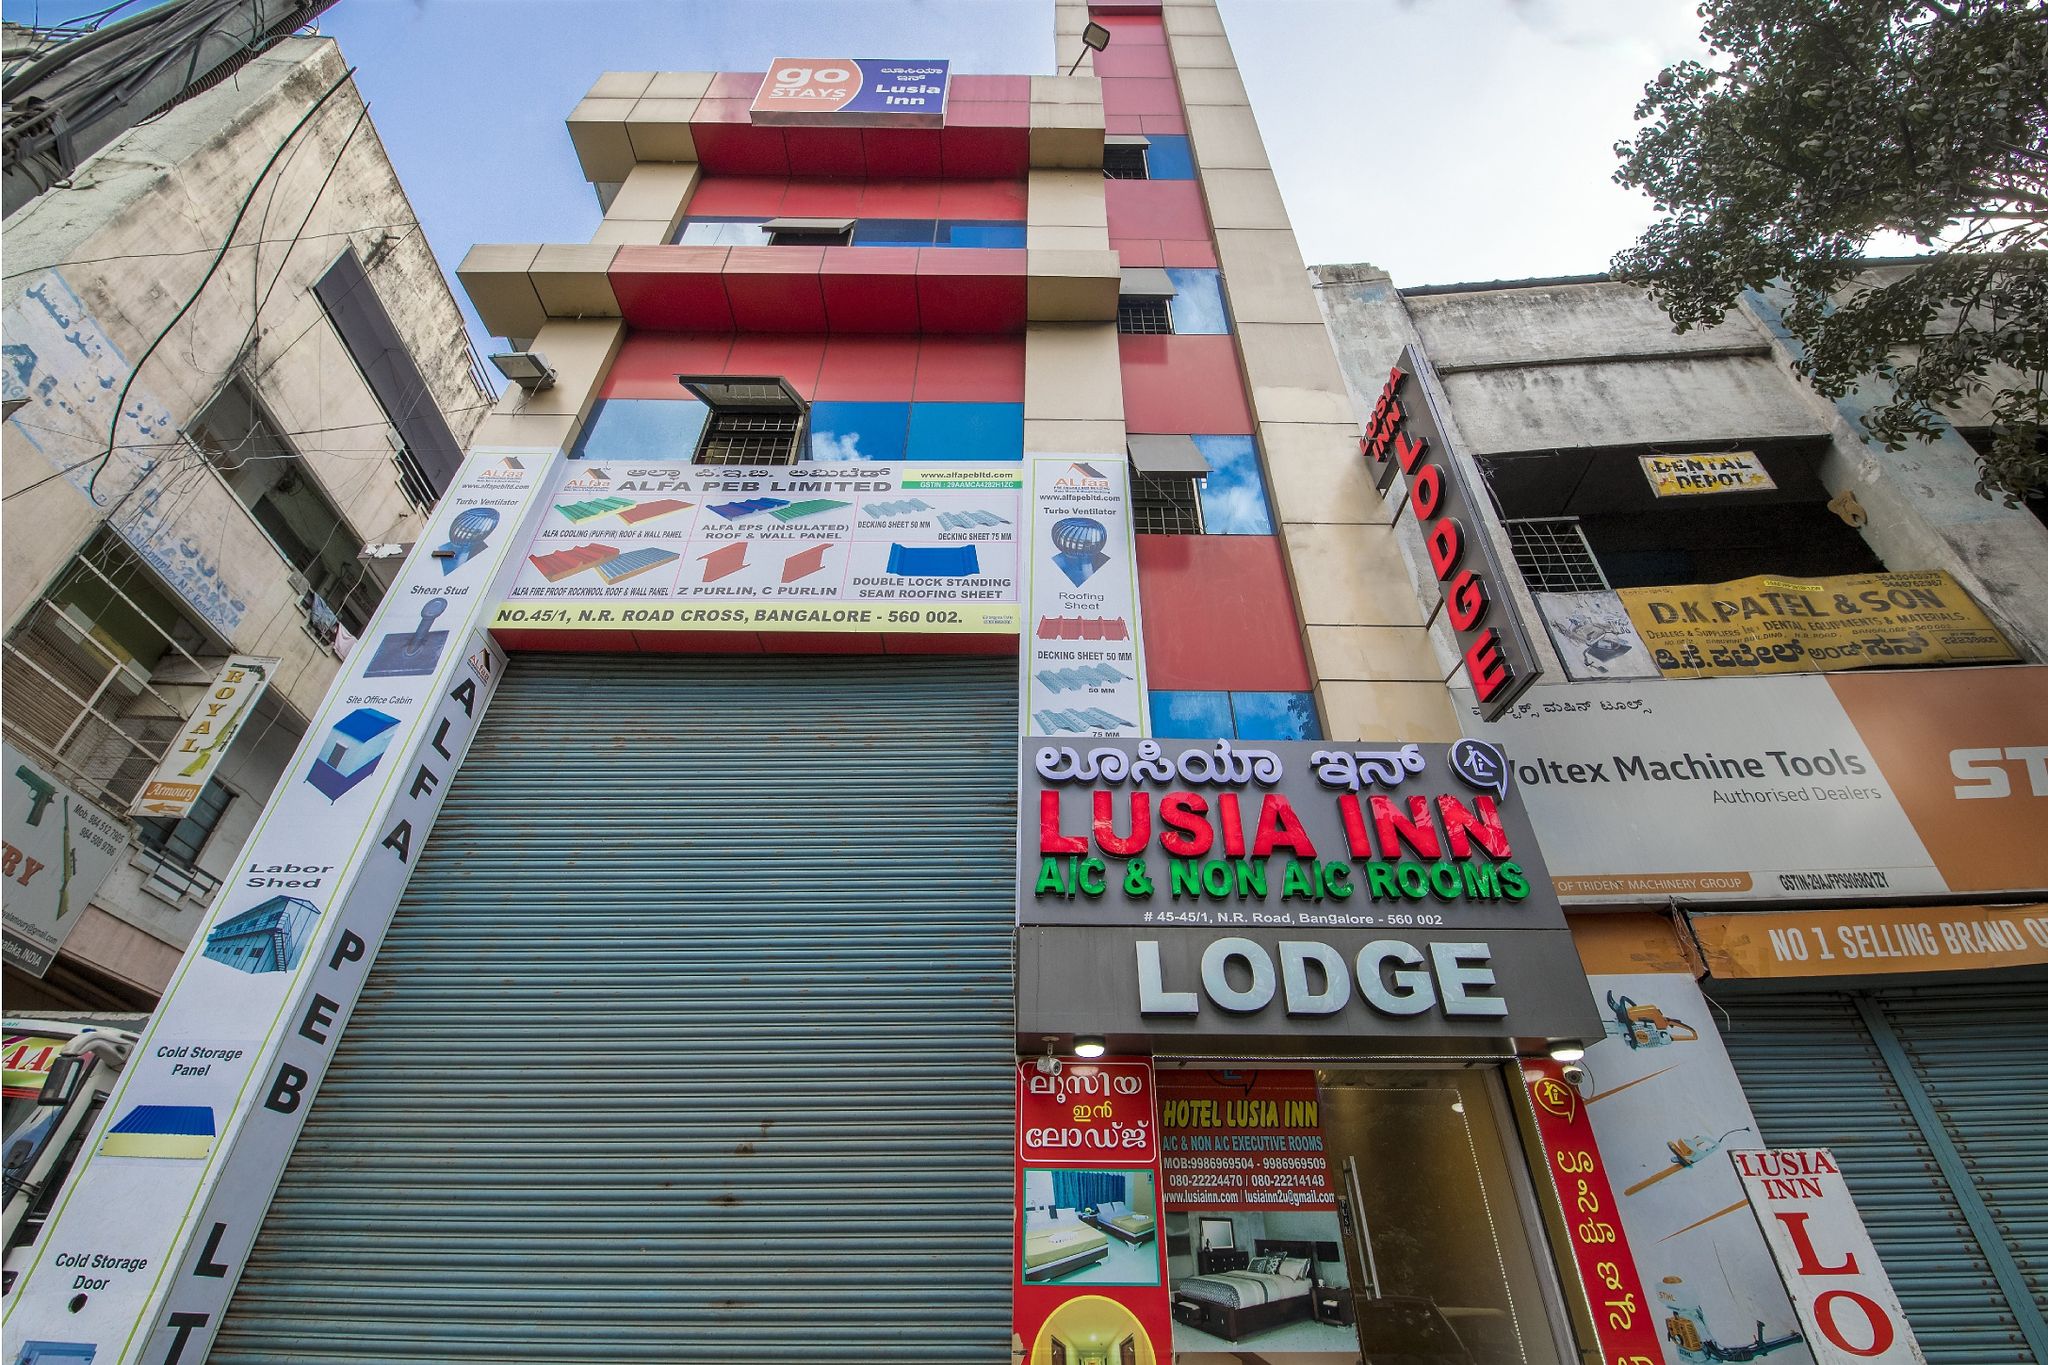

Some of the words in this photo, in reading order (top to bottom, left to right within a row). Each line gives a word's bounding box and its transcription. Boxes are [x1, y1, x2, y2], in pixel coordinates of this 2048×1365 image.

[775, 67, 850, 88] go
[771, 88, 846, 98] STAYS
[876, 84, 941, 94] Lusia
[886, 96, 925, 105] Inn
[1359, 366, 1410, 457] LUSIA
[1652, 456, 1754, 475] DENTAL
[920, 472, 1014, 480] www.alfapebltd.com
[1676, 472, 1744, 489] DEPOT
[616, 481, 692, 492] ALFA
[702, 481, 760, 492] PEB
[770, 481, 892, 492] LIMITED
[456, 498, 479, 506] Turbo
[480, 498, 519, 506] Ventilator
[1039, 494, 1121, 502] www.alfapebltd.com
[1072, 507, 1117, 515] Ventilator
[767, 524, 850, 532] (INSULATED)
[857, 520, 887, 528] DECKING
[888, 520, 910, 528] SHEET
[542, 530, 560, 538] ALFA
[560, 530, 589, 538] COOLING
[619, 530, 637, 538] ROOF
[938, 532, 968, 540] DECKING
[968, 532, 990, 540] SHEET
[1394, 428, 1516, 704] LODGE
[853, 577, 905, 586] DOUBLE
[908, 578, 943, 586] LOCK
[946, 578, 1012, 587] STANDING
[410, 584, 439, 596] Shear
[443, 584, 470, 596] Stud
[512, 587, 529, 596] ALFA
[528, 587, 544, 596] FIRE
[544, 587, 567, 596] PROOF
[567, 587, 603, 596] ROCKWOOL
[602, 587, 624, 596] ROOF
[630, 588, 649, 596] WALL
[648, 588, 669, 596] PANEL
[677, 587, 689, 595] Z
[693, 586, 757, 596] PURLIN,
[762, 586, 773, 595] C
[777, 587, 838, 596] PURLIN
[859, 590, 895, 598] SEAM
[899, 590, 957, 598] ROOFING
[960, 590, 1003, 598] SHEET
[1058, 592, 1105, 602] Roofing
[1064, 602, 1100, 610] Sheet
[1648, 592, 1830, 625] D.K.PATEL
[1834, 592, 1862, 616] &
[1859, 588, 1947, 613] SON
[496, 609, 572, 624] NO.45/1,
[578, 610, 616, 622] N.R.
[622, 610, 675, 622] ROAD
[680, 610, 749, 624] CROSS,
[754, 610, 872, 622] BANGALORE
[888, 610, 921, 623] 560
[926, 610, 963, 624] 002.
[1646, 629, 1684, 640] DEALERS
[1695, 627, 1741, 638] SUPPLIERS
[1808, 616, 1884, 631] EQUIPMENTS
[1037, 651, 1075, 660] DECKING
[1077, 652, 1105, 660] SHEET
[1106, 652, 1117, 660] 50
[1118, 652, 1133, 661] MM
[346, 695, 366, 705] Site
[366, 695, 392, 705] Office
[392, 695, 413, 705] Cabin
[179, 669, 246, 753] ROYAL
[1035, 737, 1285, 789] ಲೂಸಿಯಾ
[1309, 743, 1427, 793] ಇನ್
[1612, 752, 1767, 784] Machine
[1765, 747, 1867, 778] Tools
[148, 783, 198, 802] Armoury
[1712, 786, 1810, 805] Authorised
[1814, 785, 1882, 802] Dealers
[1039, 789, 1318, 860] LUSIA
[1336, 793, 1513, 862] INN
[248, 864, 336, 874] Labor
[245, 877, 322, 889] Shed
[1122, 857, 1155, 898] &
[1167, 858, 1269, 900] NON
[1363, 860, 1532, 902] ROOMS
[1558, 881, 1574, 892] OF
[1577, 880, 1625, 892] TRIDENT
[1628, 879, 1697, 890] MACHINERY
[1700, 878, 1742, 889] GROUP
[1156, 912, 1214, 924] 45-45/1,
[1217, 912, 1249, 923] N.R.
[1252, 913, 1296, 926] Road,
[1299, 913, 1375, 926] Bangalore
[1387, 914, 1413, 926] 560
[1416, 914, 1443, 926] 002
[1768, 926, 1809, 962] NO
[1812, 926, 1836, 960] 1
[1837, 920, 1940, 960] SELLING
[1939, 919, 2028, 955] BRAND
[1134, 936, 1509, 1020] LODGE
[263, 927, 366, 1115] PEB
[156, 1046, 188, 1059] Cold
[189, 1046, 244, 1062] Storage
[171, 1064, 212, 1077] Panel
[1163, 1099, 1223, 1128] HOTEL
[1226, 1100, 1280, 1128] LUSIA
[1284, 1100, 1319, 1128] INN
[1025, 1119, 1150, 1149] ലോഡ്ജ്
[1162, 1136, 1178, 1151] A/C
[1191, 1136, 1212, 1151] NON
[1214, 1136, 1230, 1151] A/C
[1232, 1136, 1287, 1151] EXECUTIVE
[1288, 1136, 1324, 1151] ROOMS
[1163, 1157, 1255, 1170] MOB:9986969504
[1263, 1157, 1326, 1170] 9986969509
[1736, 1151, 1839, 1177] LUSIA
[1169, 1174, 1244, 1187] 080-22224470
[1251, 1174, 1325, 1187] 080-22214148
[1761, 1178, 1824, 1200] INN
[1164, 1190, 1239, 1203] www.lusiainn.com
[55, 1252, 89, 1268] Cold
[90, 1254, 148, 1273] Storage
[71, 1275, 111, 1291] Door
